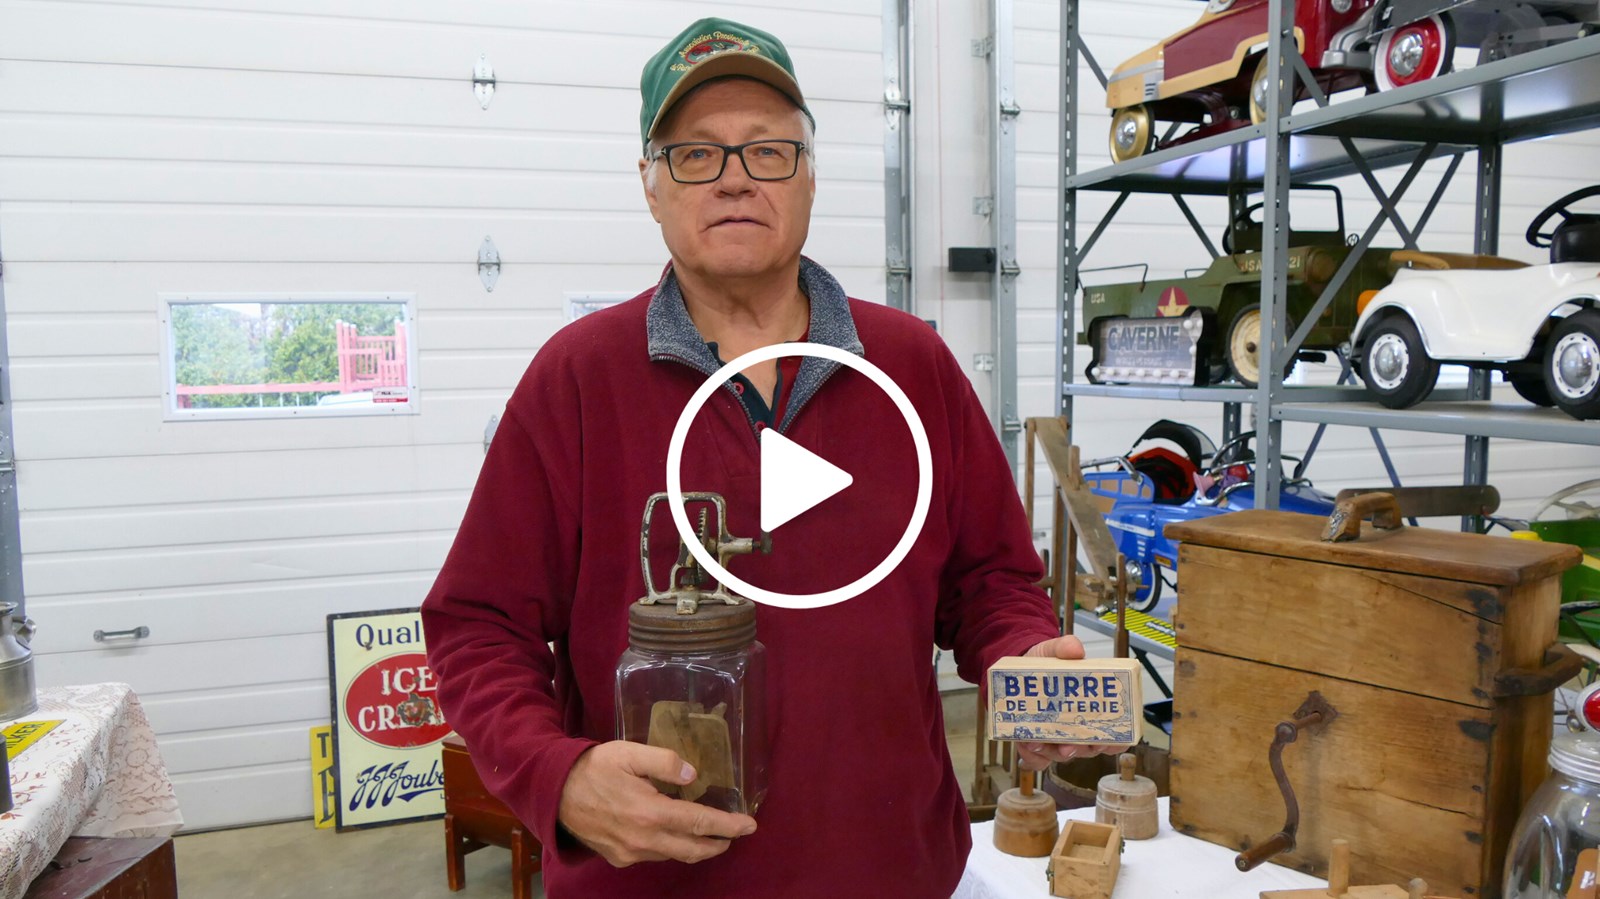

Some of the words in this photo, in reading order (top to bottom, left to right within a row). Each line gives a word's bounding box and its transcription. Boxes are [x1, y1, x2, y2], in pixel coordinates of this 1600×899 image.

[1090, 292, 1105, 304] USA
[1108, 325, 1180, 351] CAVERNE
[380, 666, 439, 696] ICE
[1004, 676, 1118, 698] BEURRE
[1006, 699, 1027, 712] DE
[1037, 700, 1120, 713] LAITERIE
